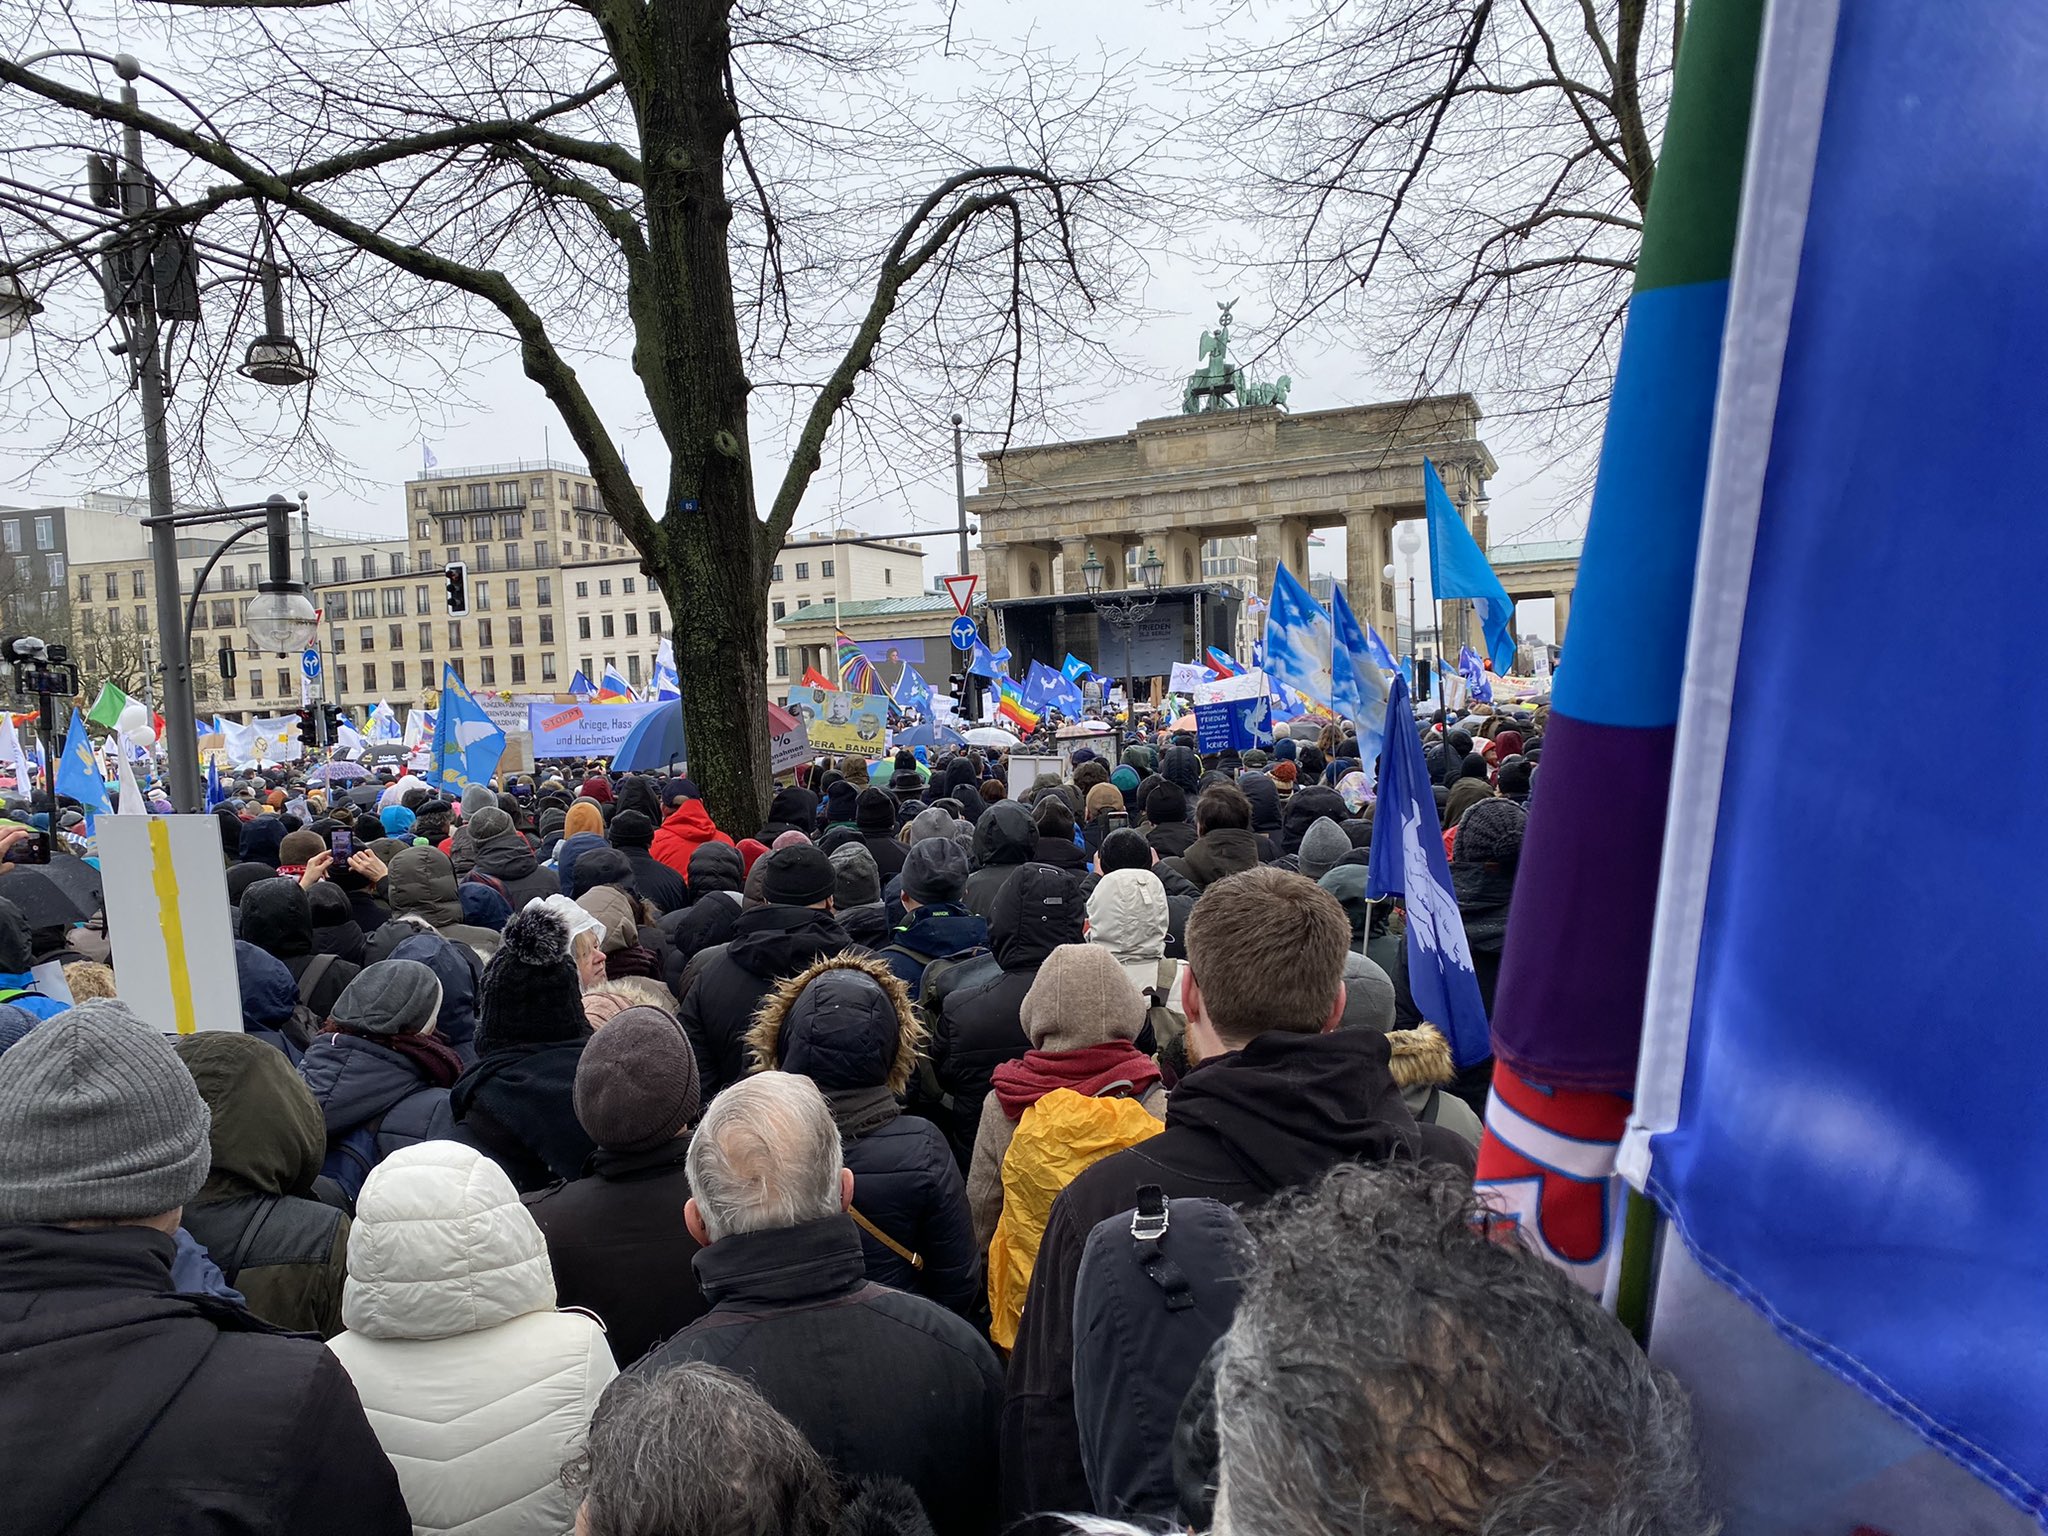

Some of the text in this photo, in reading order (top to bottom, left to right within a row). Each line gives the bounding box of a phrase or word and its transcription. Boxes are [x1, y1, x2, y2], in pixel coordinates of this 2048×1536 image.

[1138, 623, 1171, 631] FRIEDEN
[543, 709, 581, 729] STOPPT
[1200, 715, 1227, 723] FRIEDEN
[579, 718, 632, 731] Kriege, Hass
[556, 735, 572, 745] und
[845, 743, 882, 754] BANDE
[1206, 741, 1229, 750] KRIEG
[776, 756, 789, 764] Jahr
